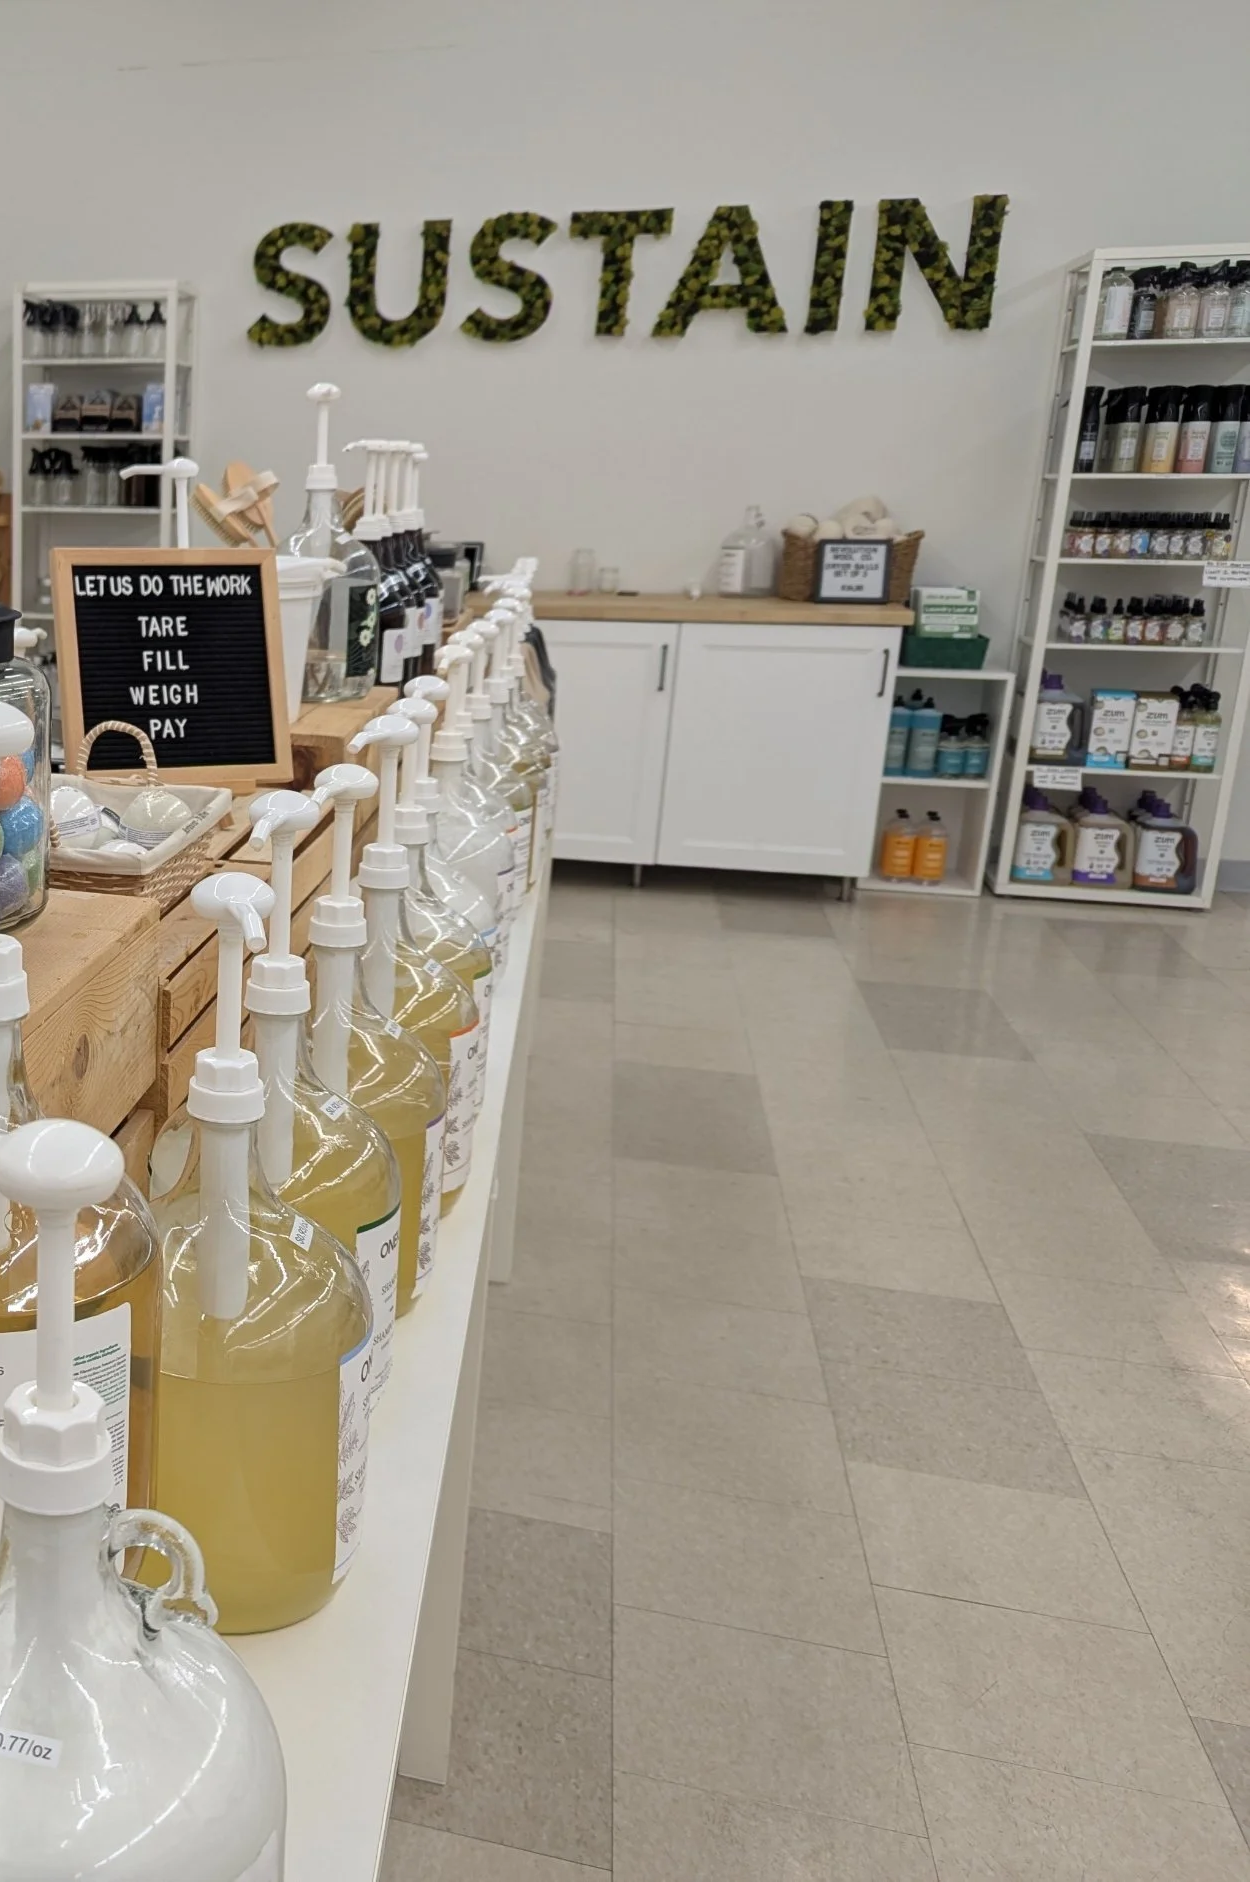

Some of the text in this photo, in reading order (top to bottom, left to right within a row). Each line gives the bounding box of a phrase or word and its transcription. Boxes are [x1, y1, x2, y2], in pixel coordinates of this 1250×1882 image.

[246, 194, 1010, 348] SUSTAIN
[74, 574, 252, 598] LET US DO THE WORK
[138, 616, 188, 638] TARE
[142, 650, 190, 672] FILL
[130, 684, 198, 706] WEIGH
[150, 718, 188, 740] PAY
